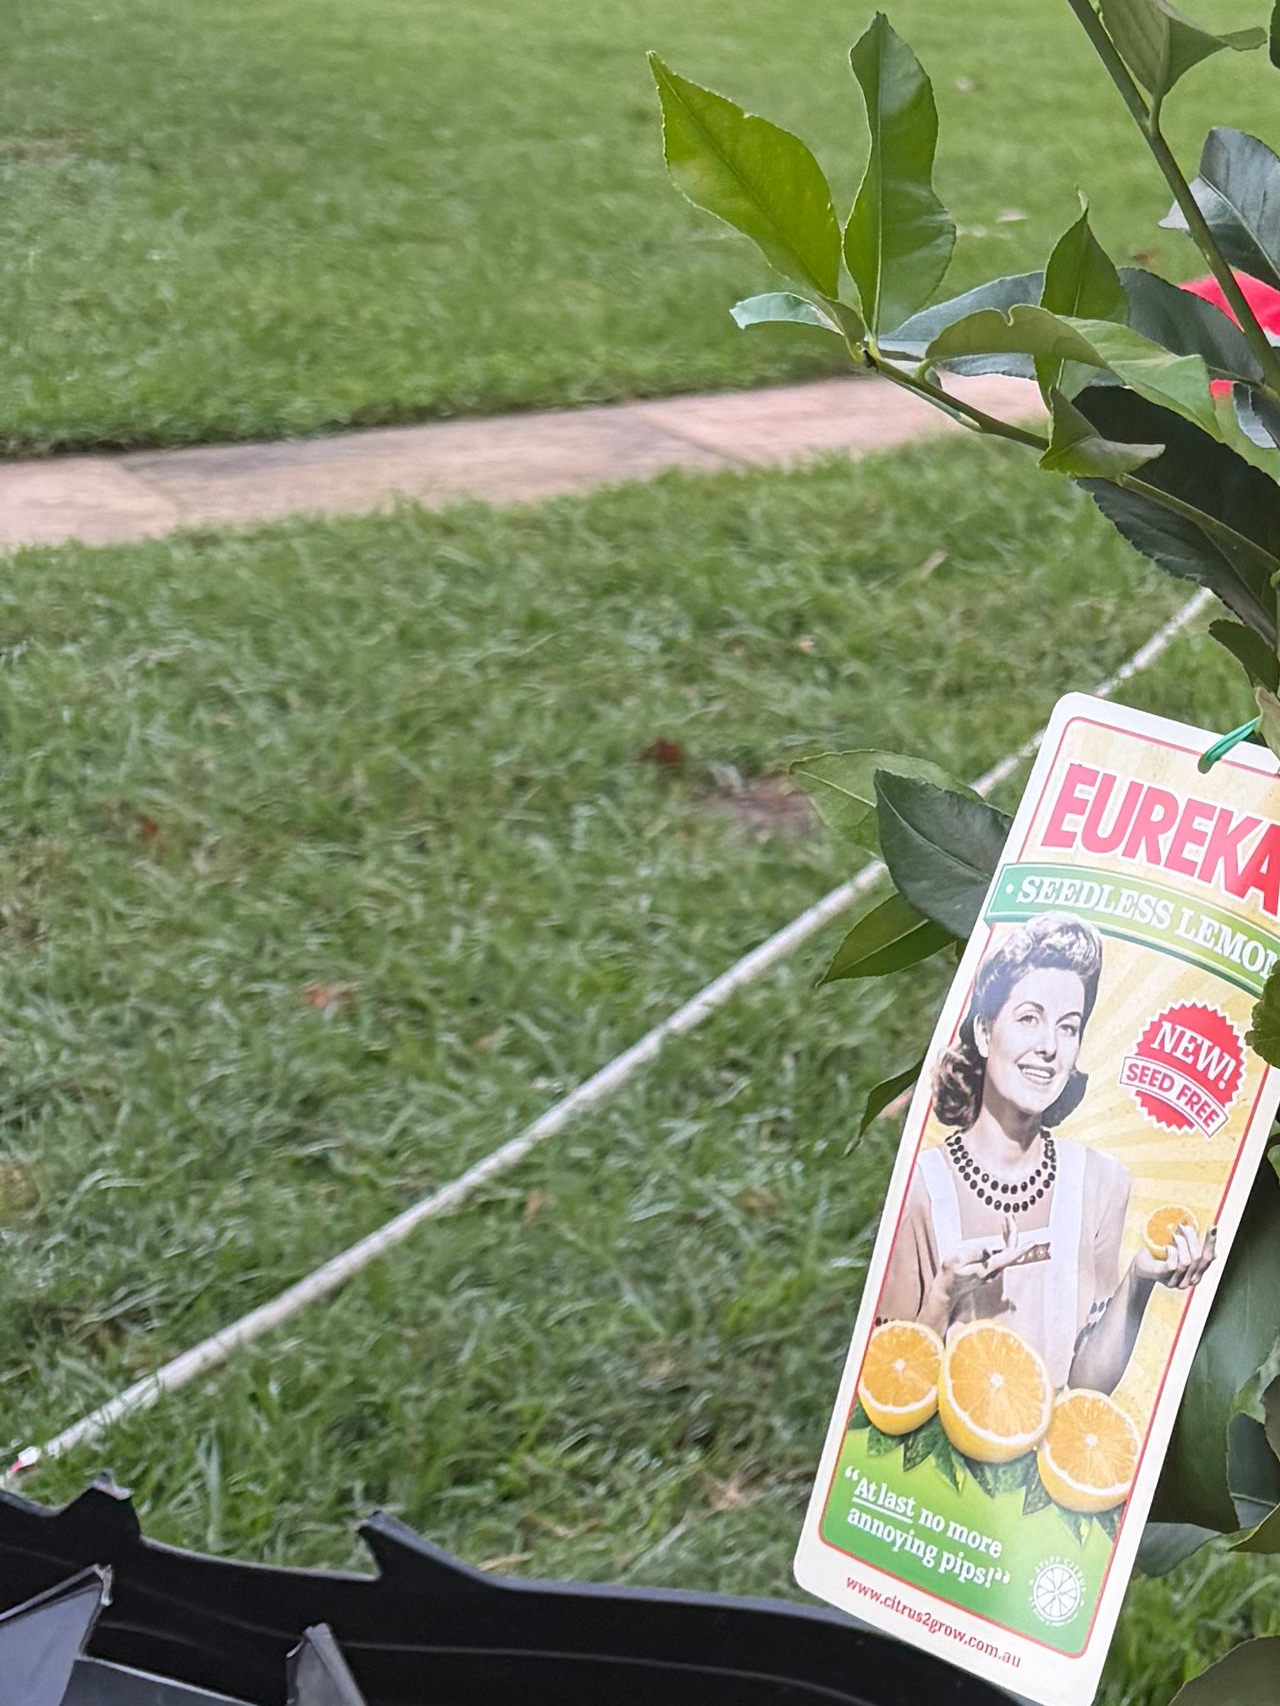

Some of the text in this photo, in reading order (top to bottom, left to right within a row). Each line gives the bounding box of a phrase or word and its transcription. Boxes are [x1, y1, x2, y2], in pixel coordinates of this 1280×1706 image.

[1016, 873, 1176, 930] SEEDLESS
[1150, 1020, 1237, 1090] NEW!
[1126, 1062, 1220, 1129] SEED FREE
[846, 1508, 939, 1569] annoying
[877, 1482, 915, 1517] last
[918, 1506, 946, 1533] no
[947, 1520, 1003, 1559] more
[845, 1575, 1022, 1669] www.citrus2grow.com.au
